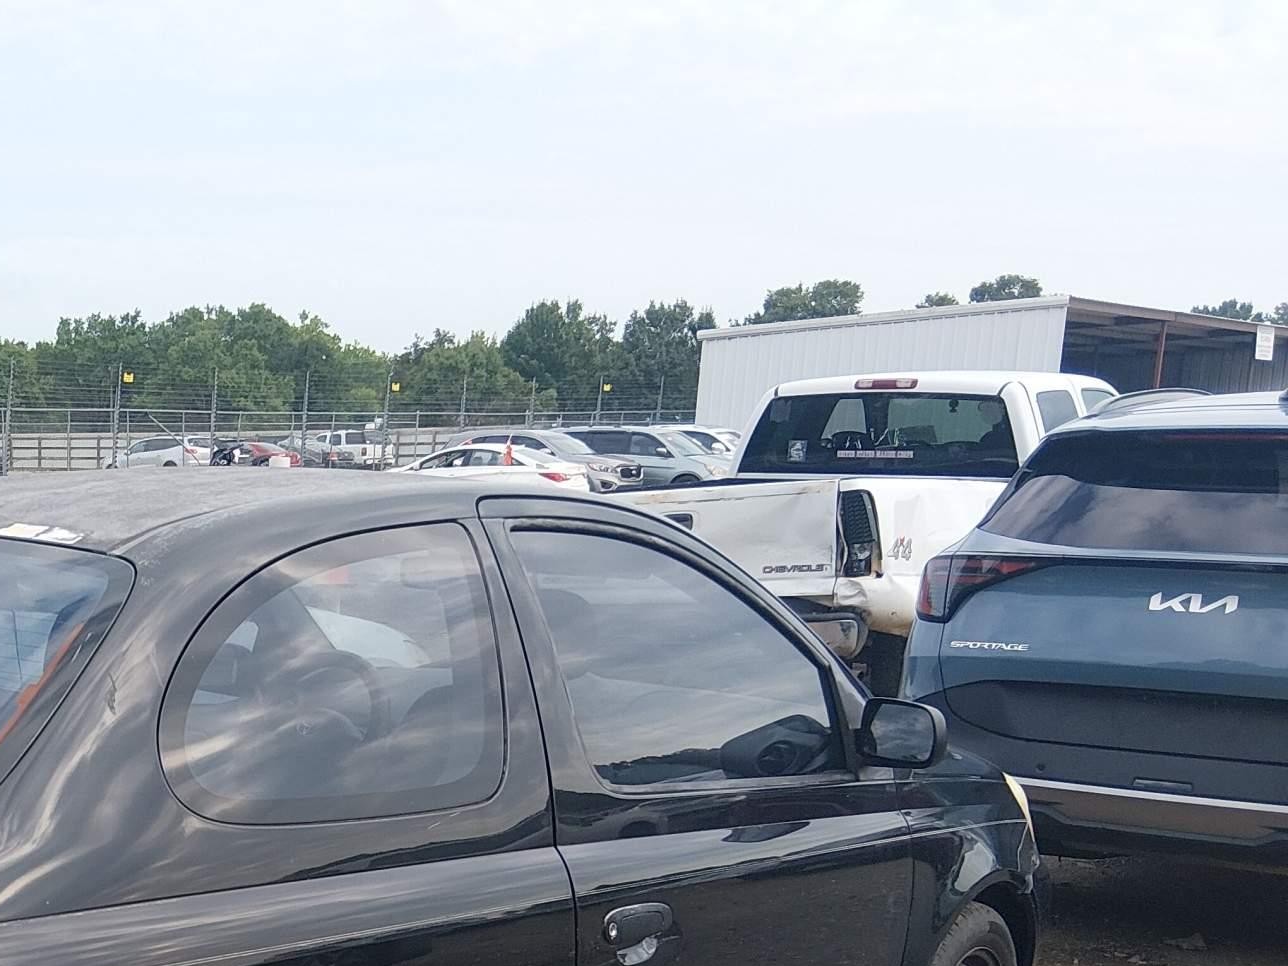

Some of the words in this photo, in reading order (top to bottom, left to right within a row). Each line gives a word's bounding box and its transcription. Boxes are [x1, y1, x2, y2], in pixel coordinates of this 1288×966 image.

[762, 563, 829, 574] CHEVROLE
[1148, 591, 1239, 615] KIA
[950, 640, 1029, 651] SPORTAGE
